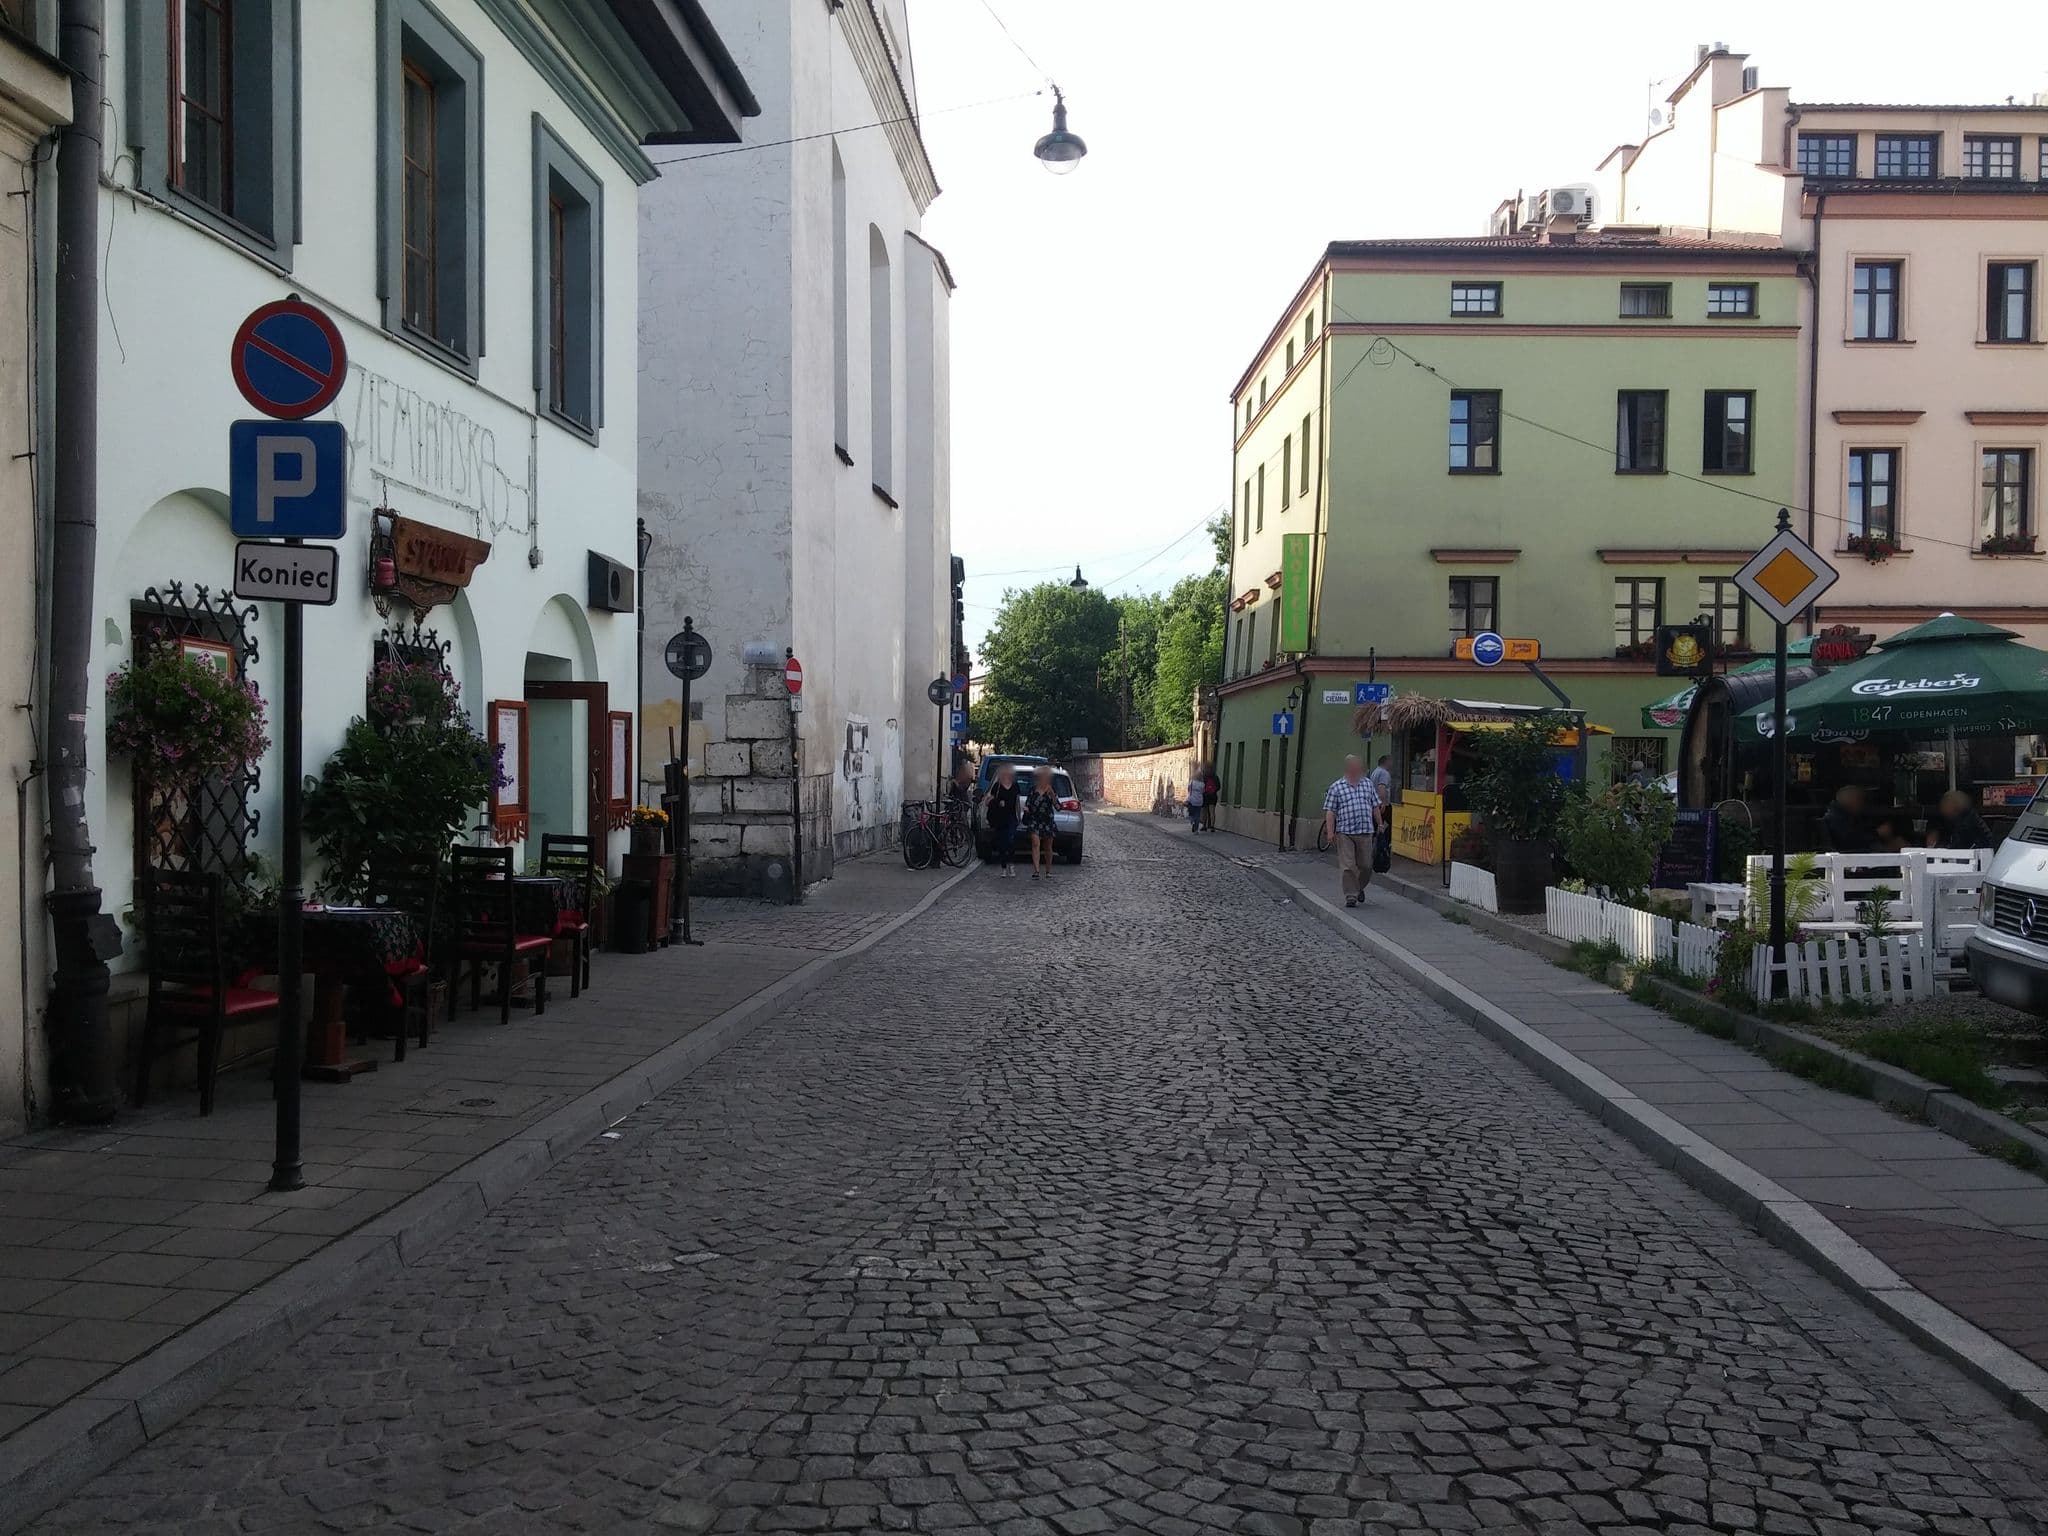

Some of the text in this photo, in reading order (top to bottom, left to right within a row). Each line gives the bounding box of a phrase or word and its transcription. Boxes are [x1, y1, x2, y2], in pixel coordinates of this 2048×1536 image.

[257, 436, 317, 522] P
[240, 558, 329, 588] Koniec
[1851, 673, 1982, 697] Carlsberg
[951, 712, 962, 728] P
[1853, 705, 1968, 722] 1847 COPENHAGEN
